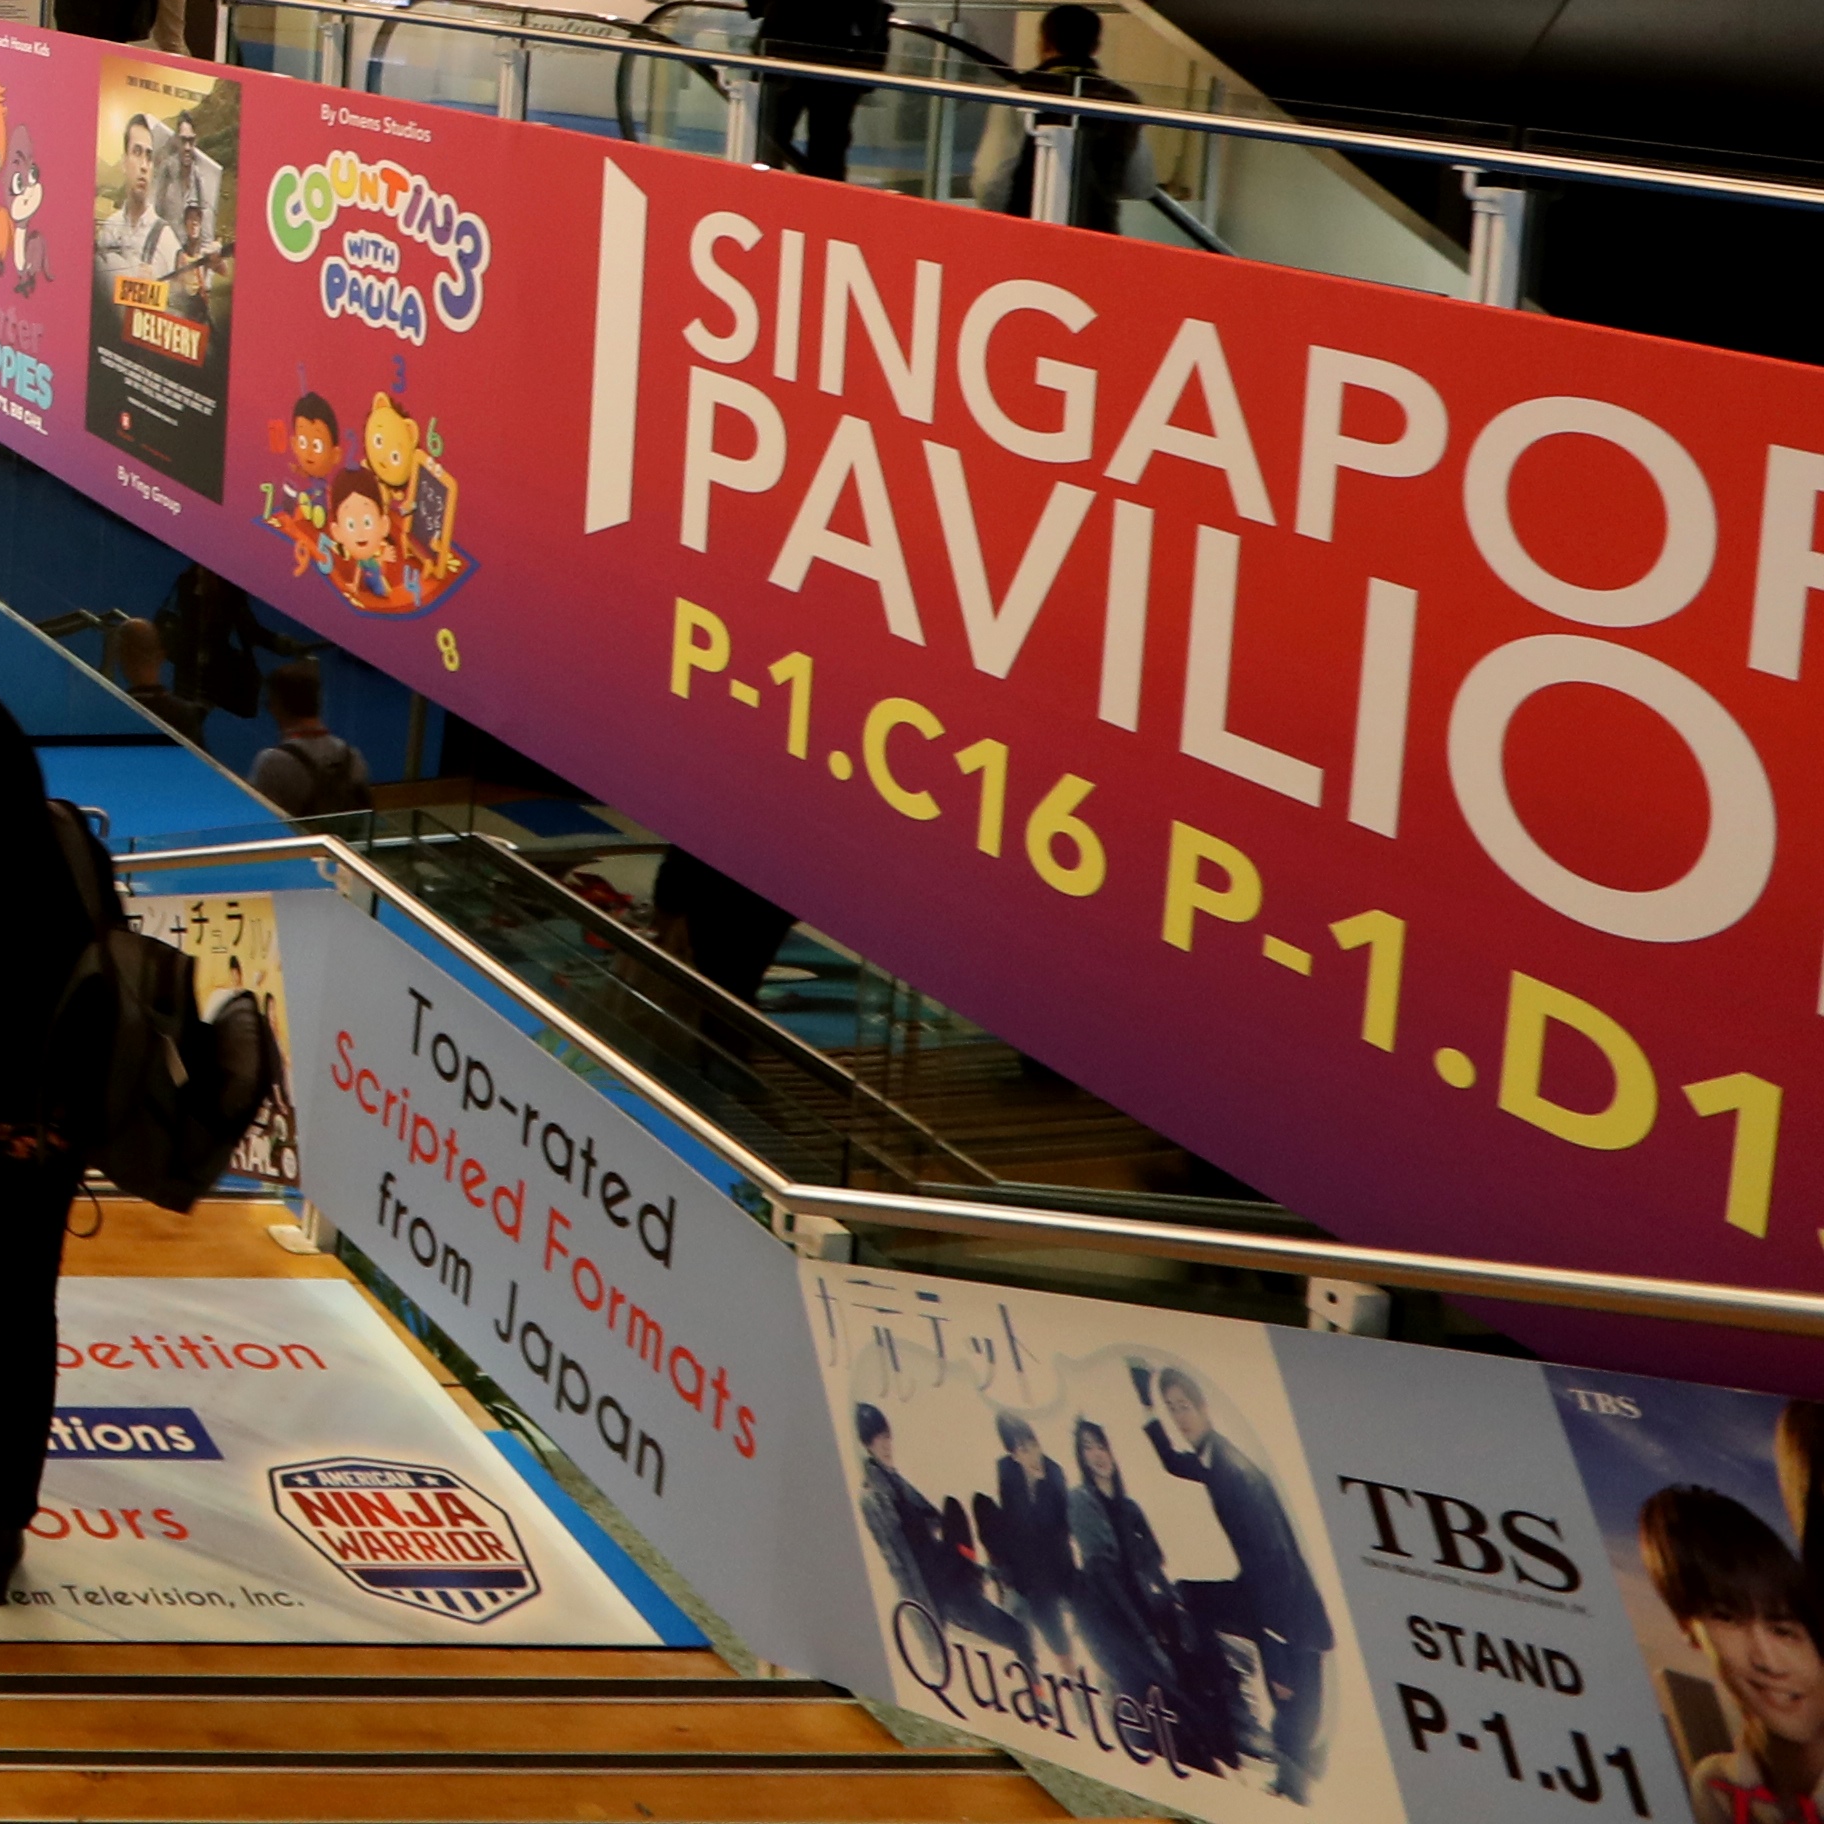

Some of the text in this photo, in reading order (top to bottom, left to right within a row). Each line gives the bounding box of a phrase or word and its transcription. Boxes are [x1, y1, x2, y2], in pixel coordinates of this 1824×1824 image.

[10, 36, 32, 53] House
[33, 41, 50, 57] Kids
[321, 103, 432, 142] By Omens Studios
[271, 155, 483, 321] COUNTING
[348, 238, 396, 267] WITH
[120, 280, 162, 307] SPECIAL
[325, 262, 423, 338] PAULA
[132, 308, 202, 360] DELIVERY
[427, 416, 445, 458] 6
[117, 465, 129, 486] By
[152, 486, 182, 515] Group
[259, 483, 275, 521] 7
[293, 542, 310, 578] 9
[317, 532, 335, 575] 5
[403, 564, 422, 608] 4
[436, 627, 461, 672] 8
[680, 366, 1824, 944] PAVILIO
[669, 597, 1108, 898] P-1.C16
[408, 987, 678, 1270] Top-rated
[329, 1030, 758, 1461] Scripted Formats
[376, 1172, 666, 1498] from Japan
[815, 1274, 1042, 1410] カルテット
[1566, 1388, 1643, 1419] TBS
[313, 1470, 419, 1489] AMERICAN
[286, 1491, 493, 1527] NINJA
[316, 1531, 519, 1563] WARRIOR
[1337, 1474, 1583, 1594] TBS
[60, 1584, 238, 1612] Television,
[245, 1586, 306, 1608] Inc.
[1406, 1613, 1584, 1697] STAND
[892, 1599, 1190, 1779] Quartet
[1394, 1681, 1653, 1820] P-1.J1
